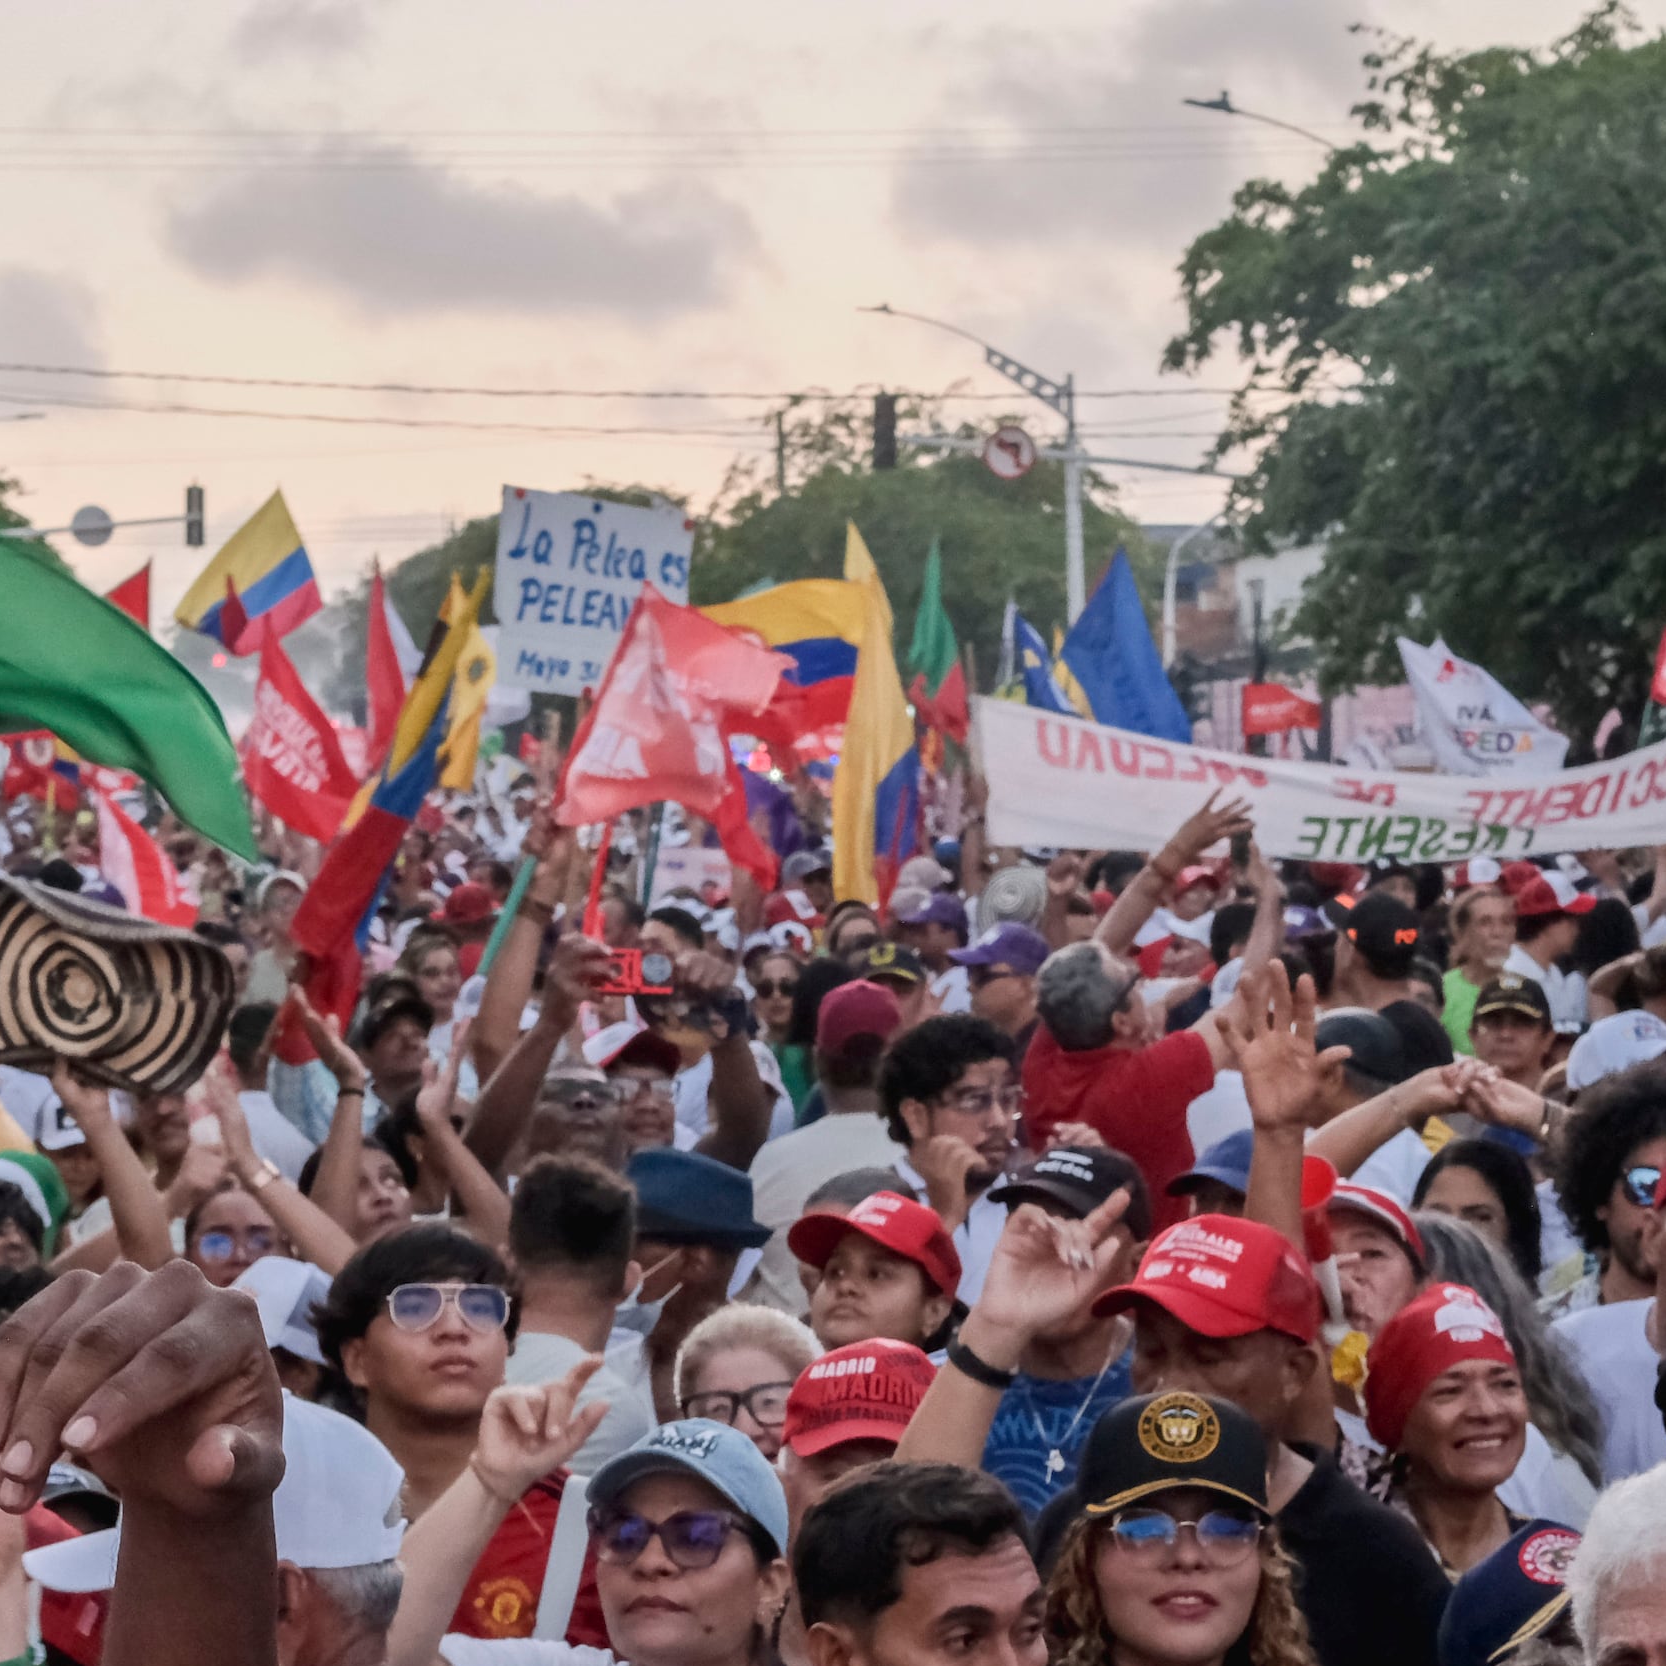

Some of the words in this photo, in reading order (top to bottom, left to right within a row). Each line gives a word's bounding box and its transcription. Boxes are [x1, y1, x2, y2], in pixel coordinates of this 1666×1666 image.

[508, 502, 553, 566] La
[570, 518, 646, 580] Pelea
[660, 551, 689, 589] es
[516, 649, 571, 683] Mayo
[808, 1356, 877, 1380] MADRID
